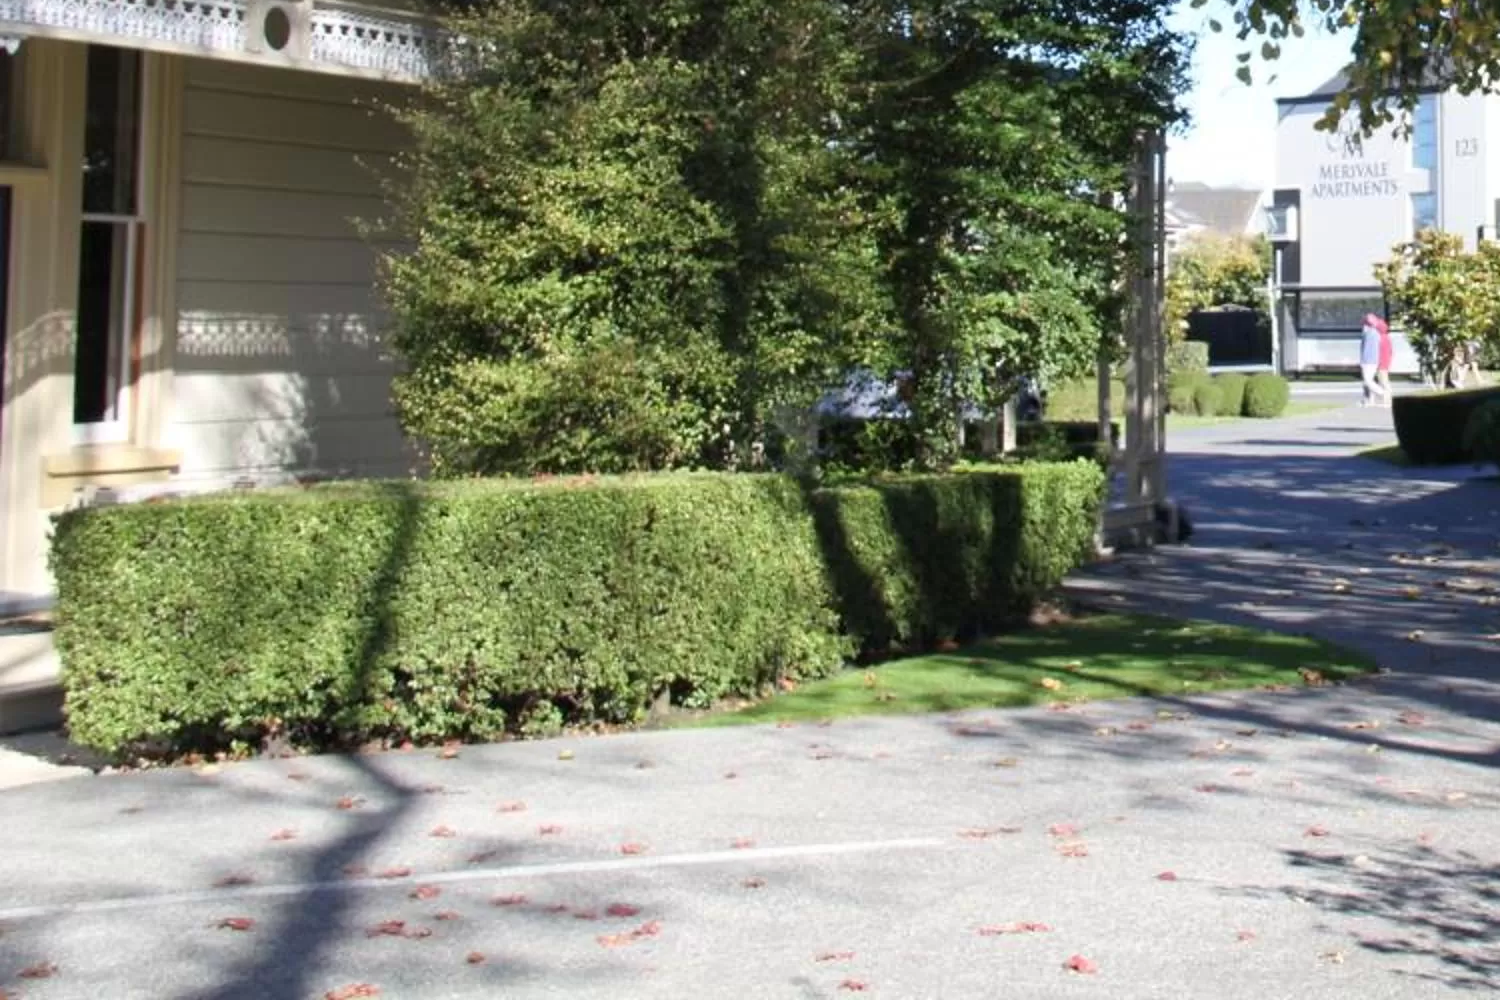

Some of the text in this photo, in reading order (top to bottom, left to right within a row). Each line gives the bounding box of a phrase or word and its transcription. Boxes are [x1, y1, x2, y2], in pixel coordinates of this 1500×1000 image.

[1455, 139, 1478, 157] 123
[1319, 161, 1388, 180] MERIVALE
[1312, 178, 1398, 199] APARTMENTS
